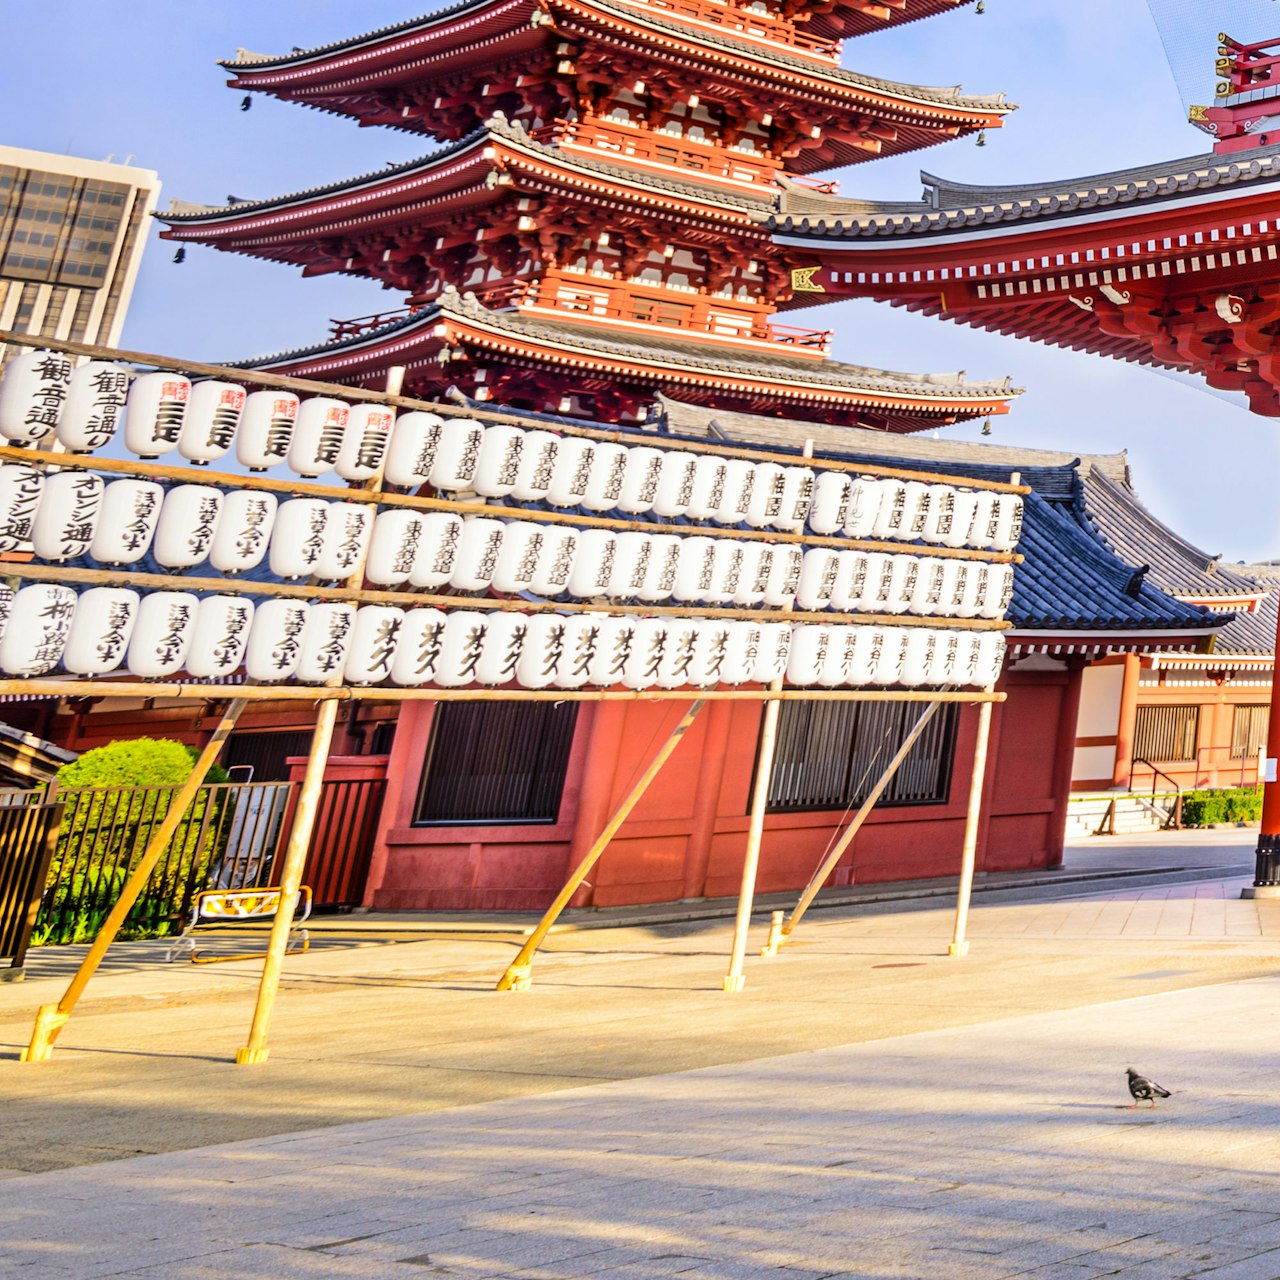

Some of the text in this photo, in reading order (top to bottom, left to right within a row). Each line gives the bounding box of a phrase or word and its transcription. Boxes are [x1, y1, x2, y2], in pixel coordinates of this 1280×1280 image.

[25, 356, 72, 440] 観音通り
[89, 370, 129, 449] 観音通り
[412, 424, 442, 477] 東武鉄道
[455, 429, 482, 480] 東武鉄道
[497, 435, 524, 485] 東武鉄道
[531, 441, 558, 490] 東武鉄道
[569, 447, 595, 496] 東武鉄道
[604, 453, 627, 500] 東武鉄道
[638, 457, 663, 503] 東武鉄道
[676, 461, 697, 506] 東武鉄道
[707, 465, 727, 510] 東武鉄道
[737, 469, 756, 514] 東武鉄道
[122, 490, 156, 552] 浅草今半
[188, 497, 218, 556] 浅草今半
[236, 499, 268, 558] 浅草今半
[302, 508, 328, 565] 浅草今半
[337, 512, 365, 568] 浅草今半
[392, 520, 422, 573] 東武鉄道
[431, 521, 460, 573] 東武鉄道
[475, 529, 503, 580] 東武鉄道
[514, 532, 543, 582] 東武鉄道
[548, 536, 576, 585] 東武鉄道
[595, 539, 617, 588] 東武鉄道
[629, 541, 652, 588] 東武鉄道
[657, 544, 680, 591] 東武鉄道
[698, 545, 716, 590] 東武鉄道
[722, 548, 744, 594] 東武鉄道
[97, 601, 130, 663] 浅草今半
[157, 603, 190, 665] 浅草今半
[214, 606, 248, 668] 浅草今半
[272, 608, 305, 669] 浅草今半
[317, 611, 350, 672] 浅草今半
[367, 617, 402, 673] 米久
[414, 621, 446, 675] 米久
[457, 624, 488, 677] 米久
[500, 623, 528, 676] 米久
[540, 624, 566, 676] 米久
[571, 625, 600, 676] 米久
[609, 627, 635, 675] 米久
[643, 629, 669, 678] 米久
[672, 629, 699, 677] 米久
[705, 630, 730, 676] 米久
